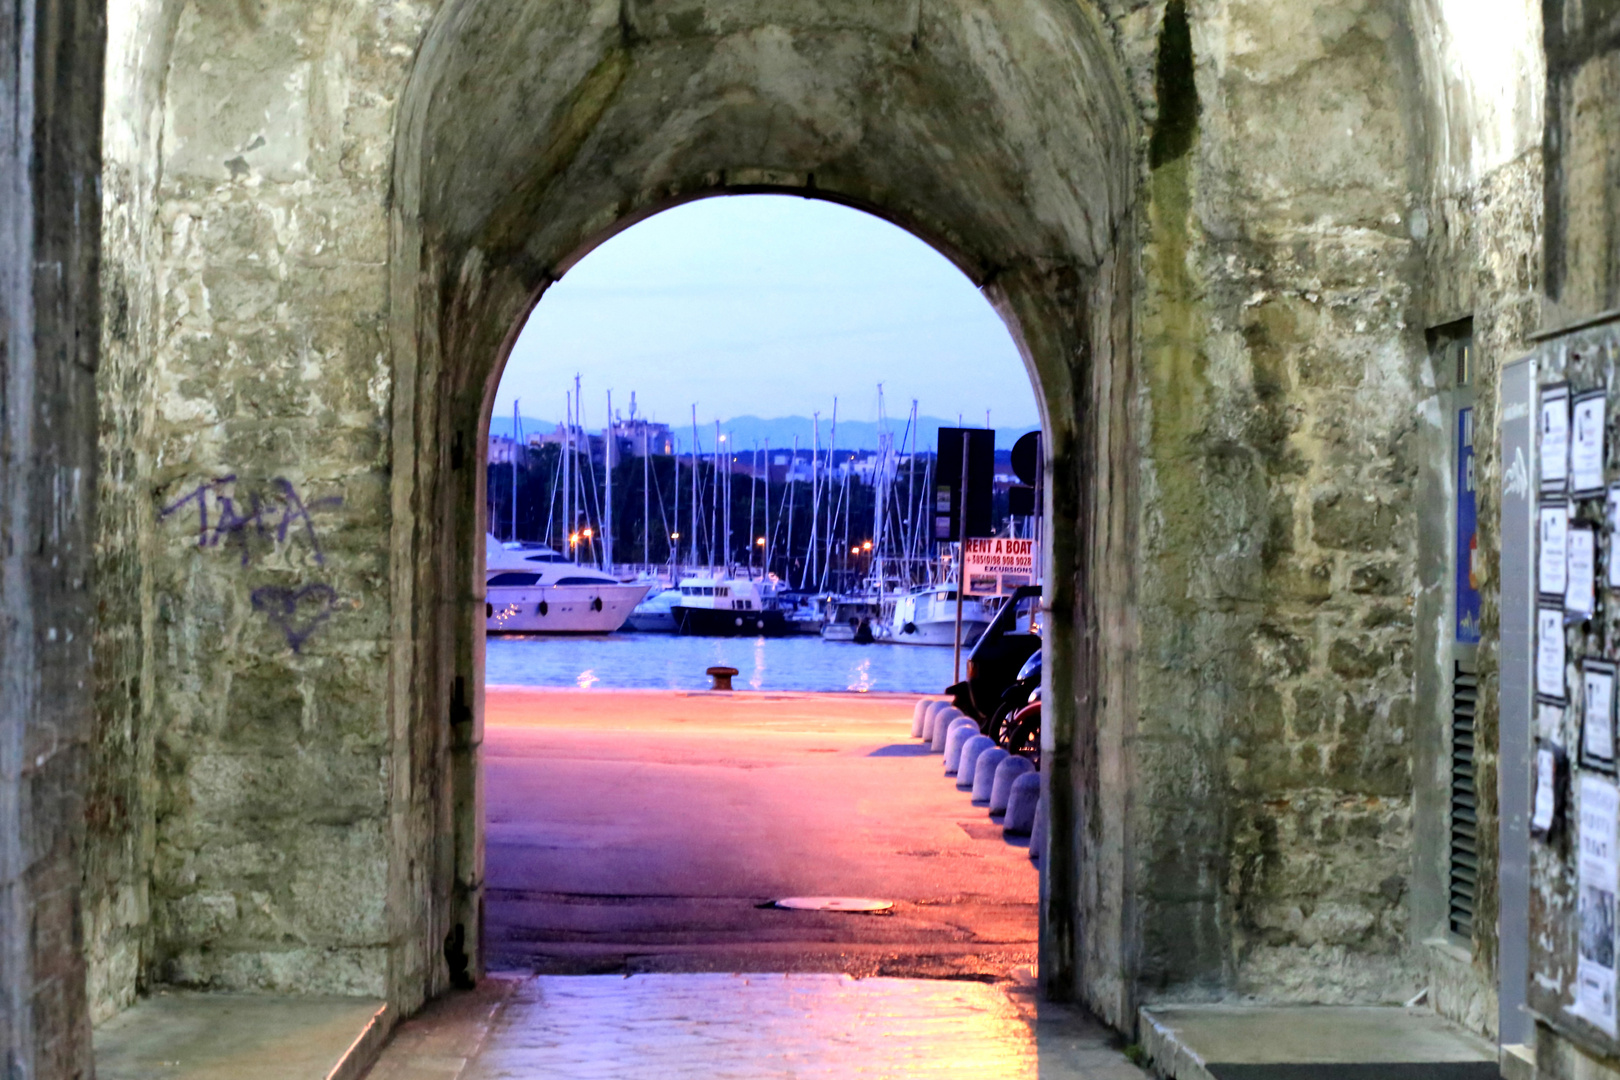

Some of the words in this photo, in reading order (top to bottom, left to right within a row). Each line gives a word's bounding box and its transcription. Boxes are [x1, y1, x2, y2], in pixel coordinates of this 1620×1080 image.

[966, 540, 992, 553] RENT
[995, 540, 1002, 554] A
[1006, 541, 1032, 555] BOAT
[984, 565, 1032, 574] EXCURSIONS
